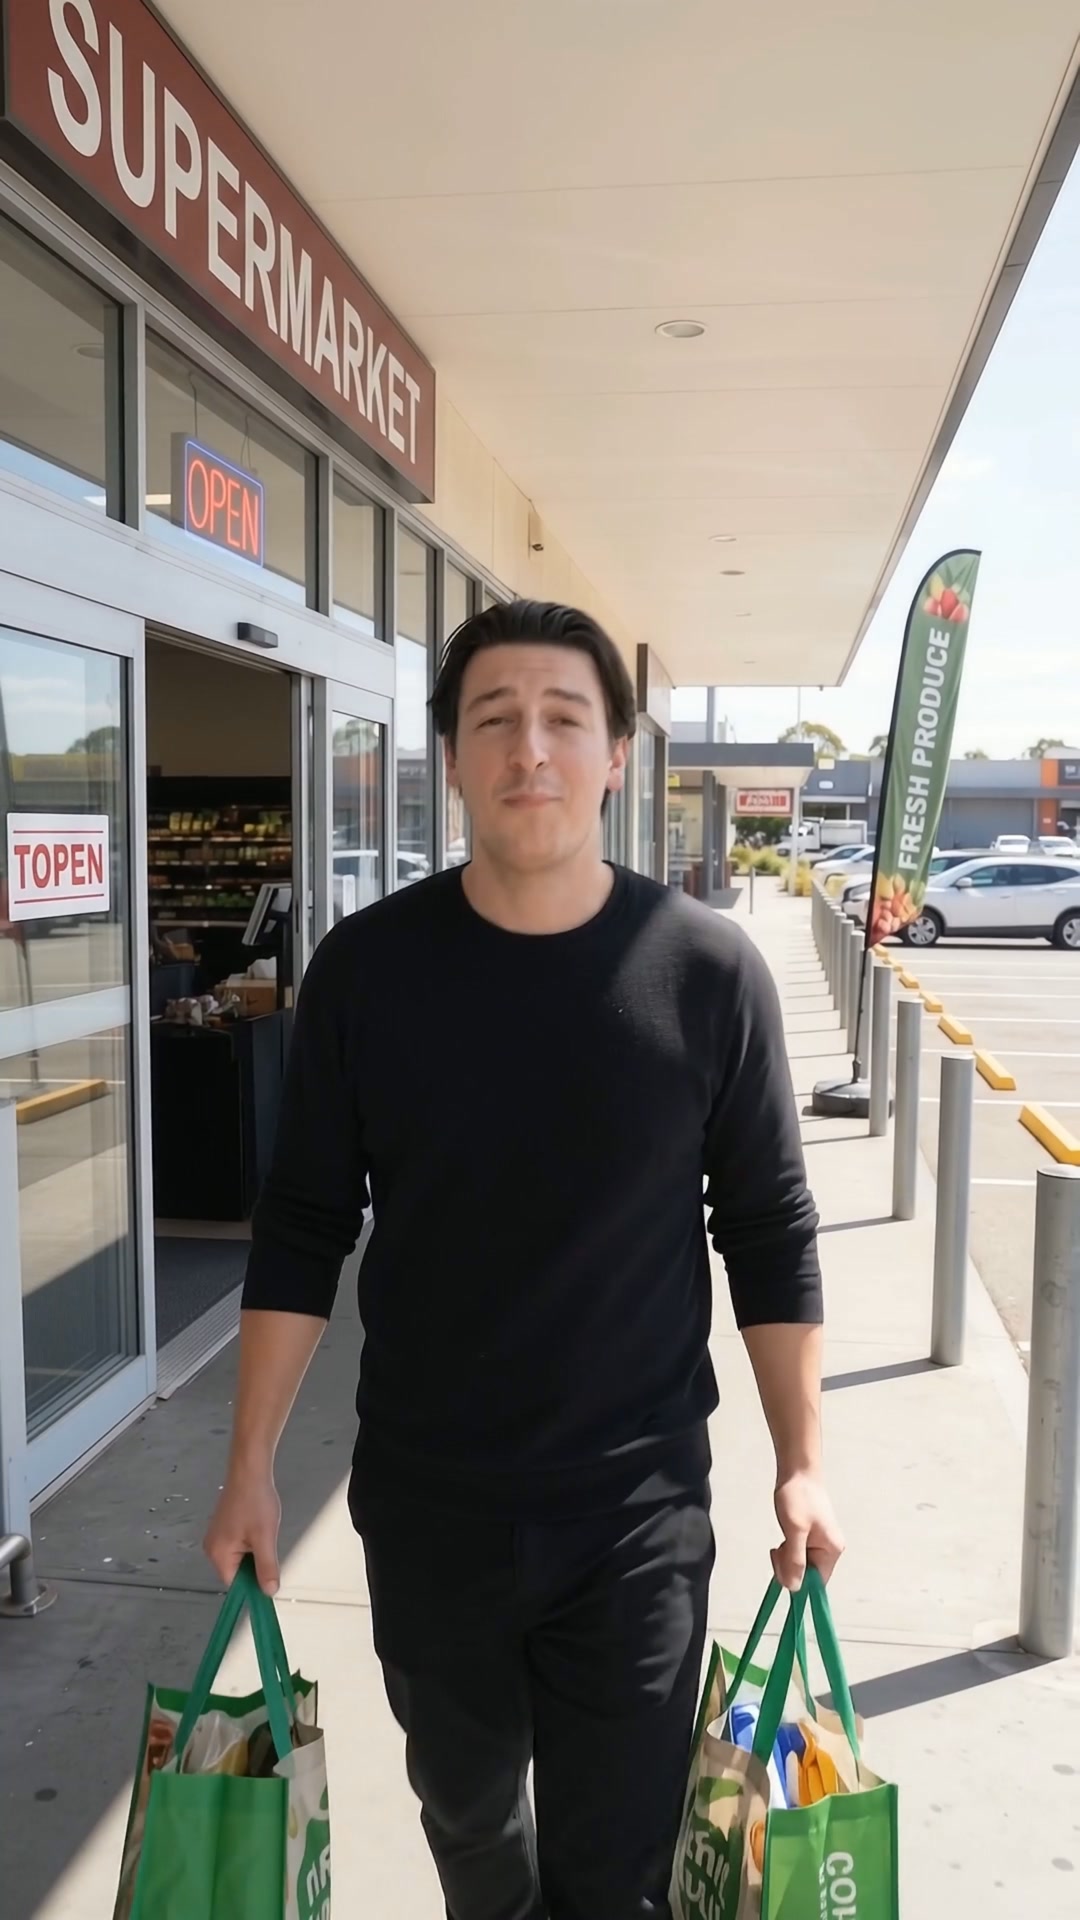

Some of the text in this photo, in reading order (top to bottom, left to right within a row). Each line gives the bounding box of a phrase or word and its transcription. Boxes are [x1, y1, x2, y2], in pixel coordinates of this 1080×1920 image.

[48, 0, 420, 464] SUPERMARKET
[188, 459, 258, 556] OPEN
[898, 627, 950, 870] FRESH PRODUCE
[14, 843, 103, 889] TOPEN
